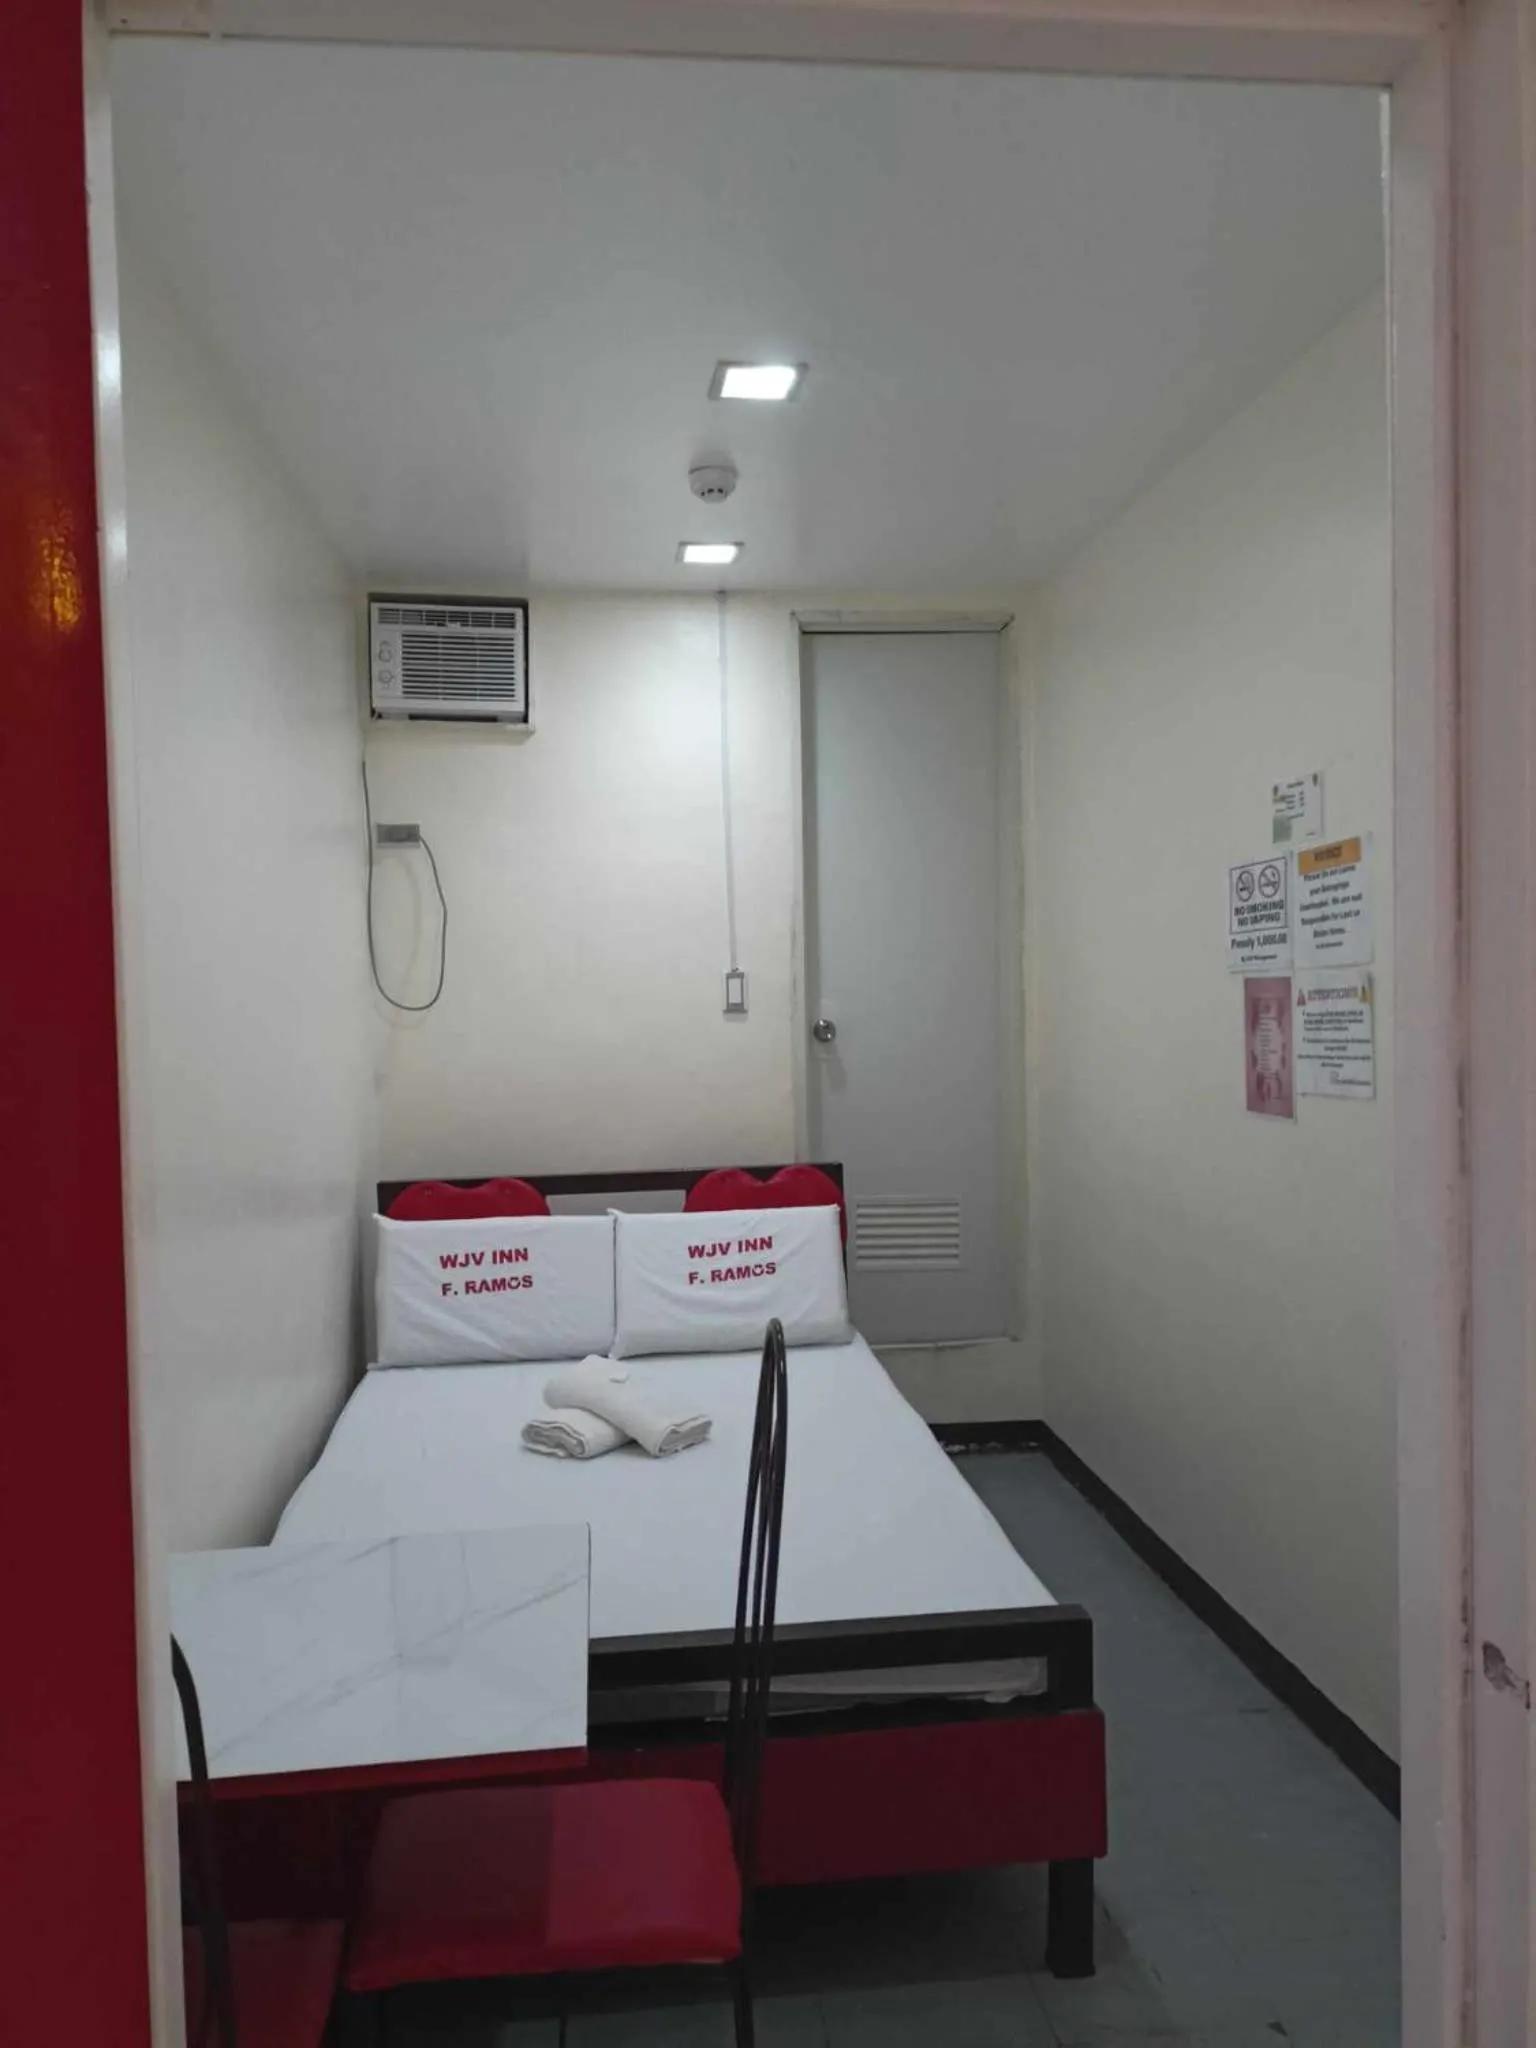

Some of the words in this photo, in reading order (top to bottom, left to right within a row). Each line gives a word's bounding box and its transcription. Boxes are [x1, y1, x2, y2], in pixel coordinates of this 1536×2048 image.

[1234, 905, 1246, 916] NO
[1237, 915, 1249, 926] NO
[439, 1251, 485, 1269] WJV
[491, 1247, 529, 1265] INN
[687, 1241, 732, 1259] WJV
[737, 1236, 774, 1253] INN
[688, 1271, 705, 1285] F.
[710, 1262, 777, 1283] RAMOS
[441, 1282, 459, 1296] F.
[464, 1274, 534, 1295] RAMOS
